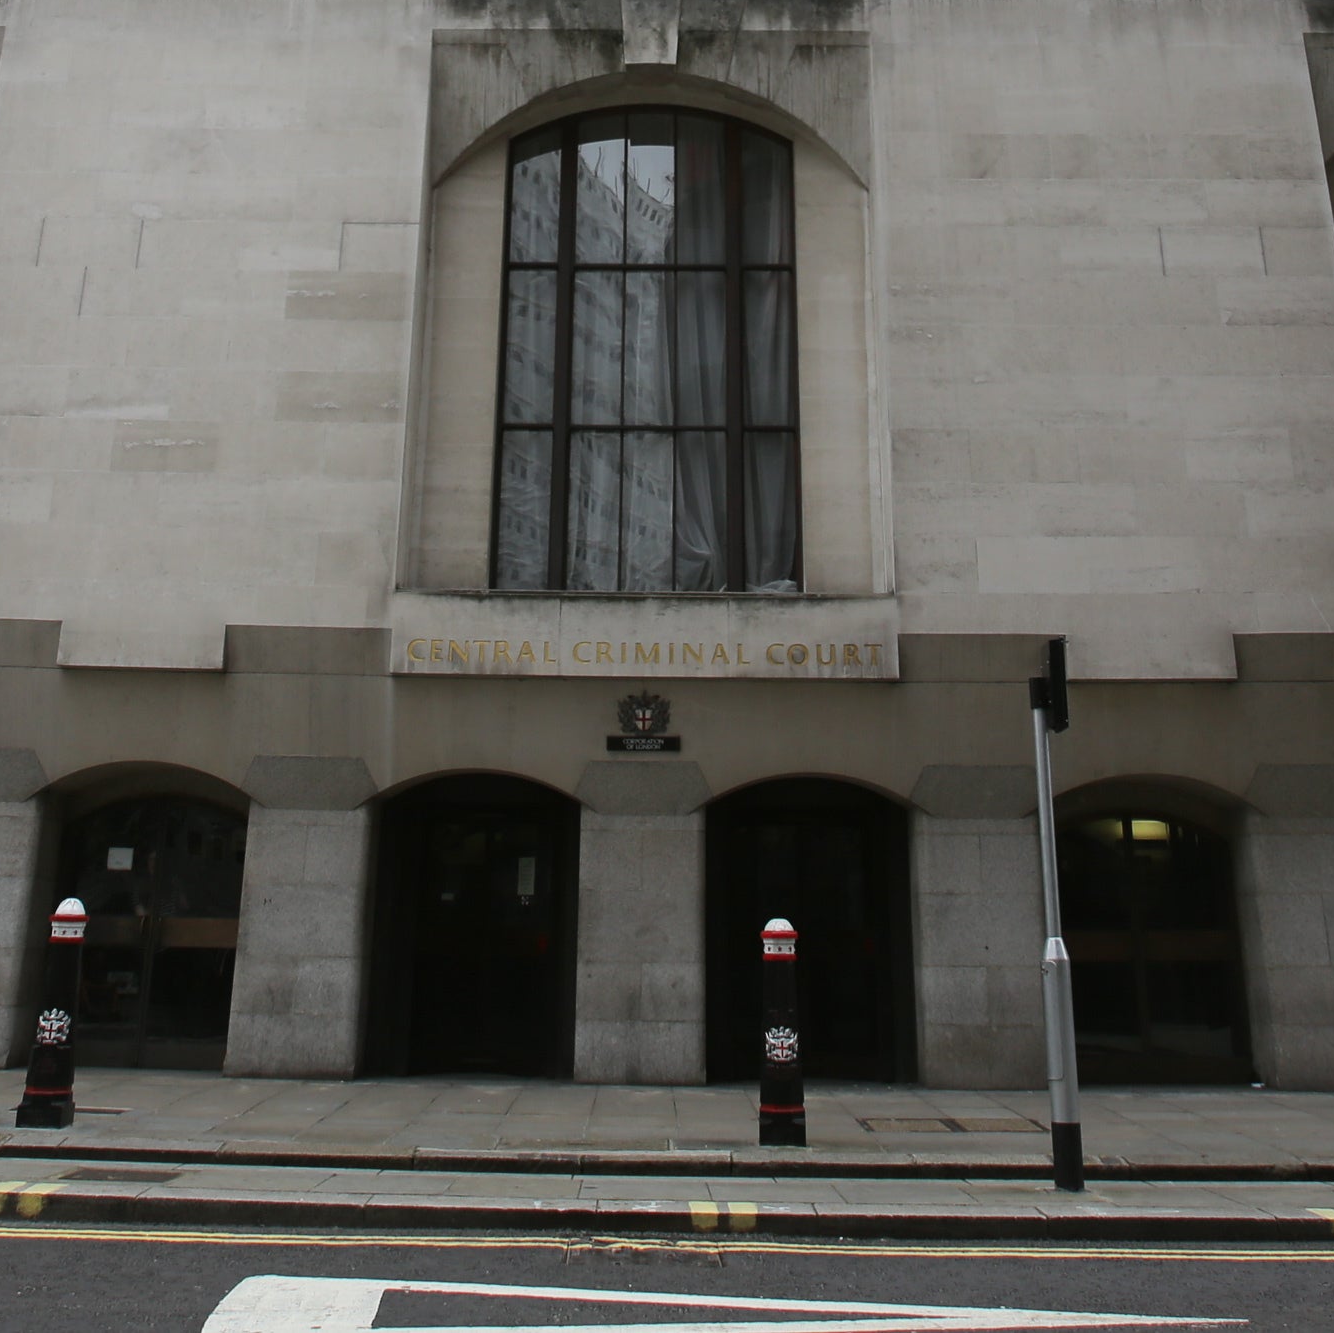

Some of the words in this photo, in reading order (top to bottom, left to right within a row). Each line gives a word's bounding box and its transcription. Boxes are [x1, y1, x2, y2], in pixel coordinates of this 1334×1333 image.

[406, 638, 557, 664] CENTRAL
[572, 641, 750, 665] CRIMINAL
[765, 643, 883, 666] COURT
